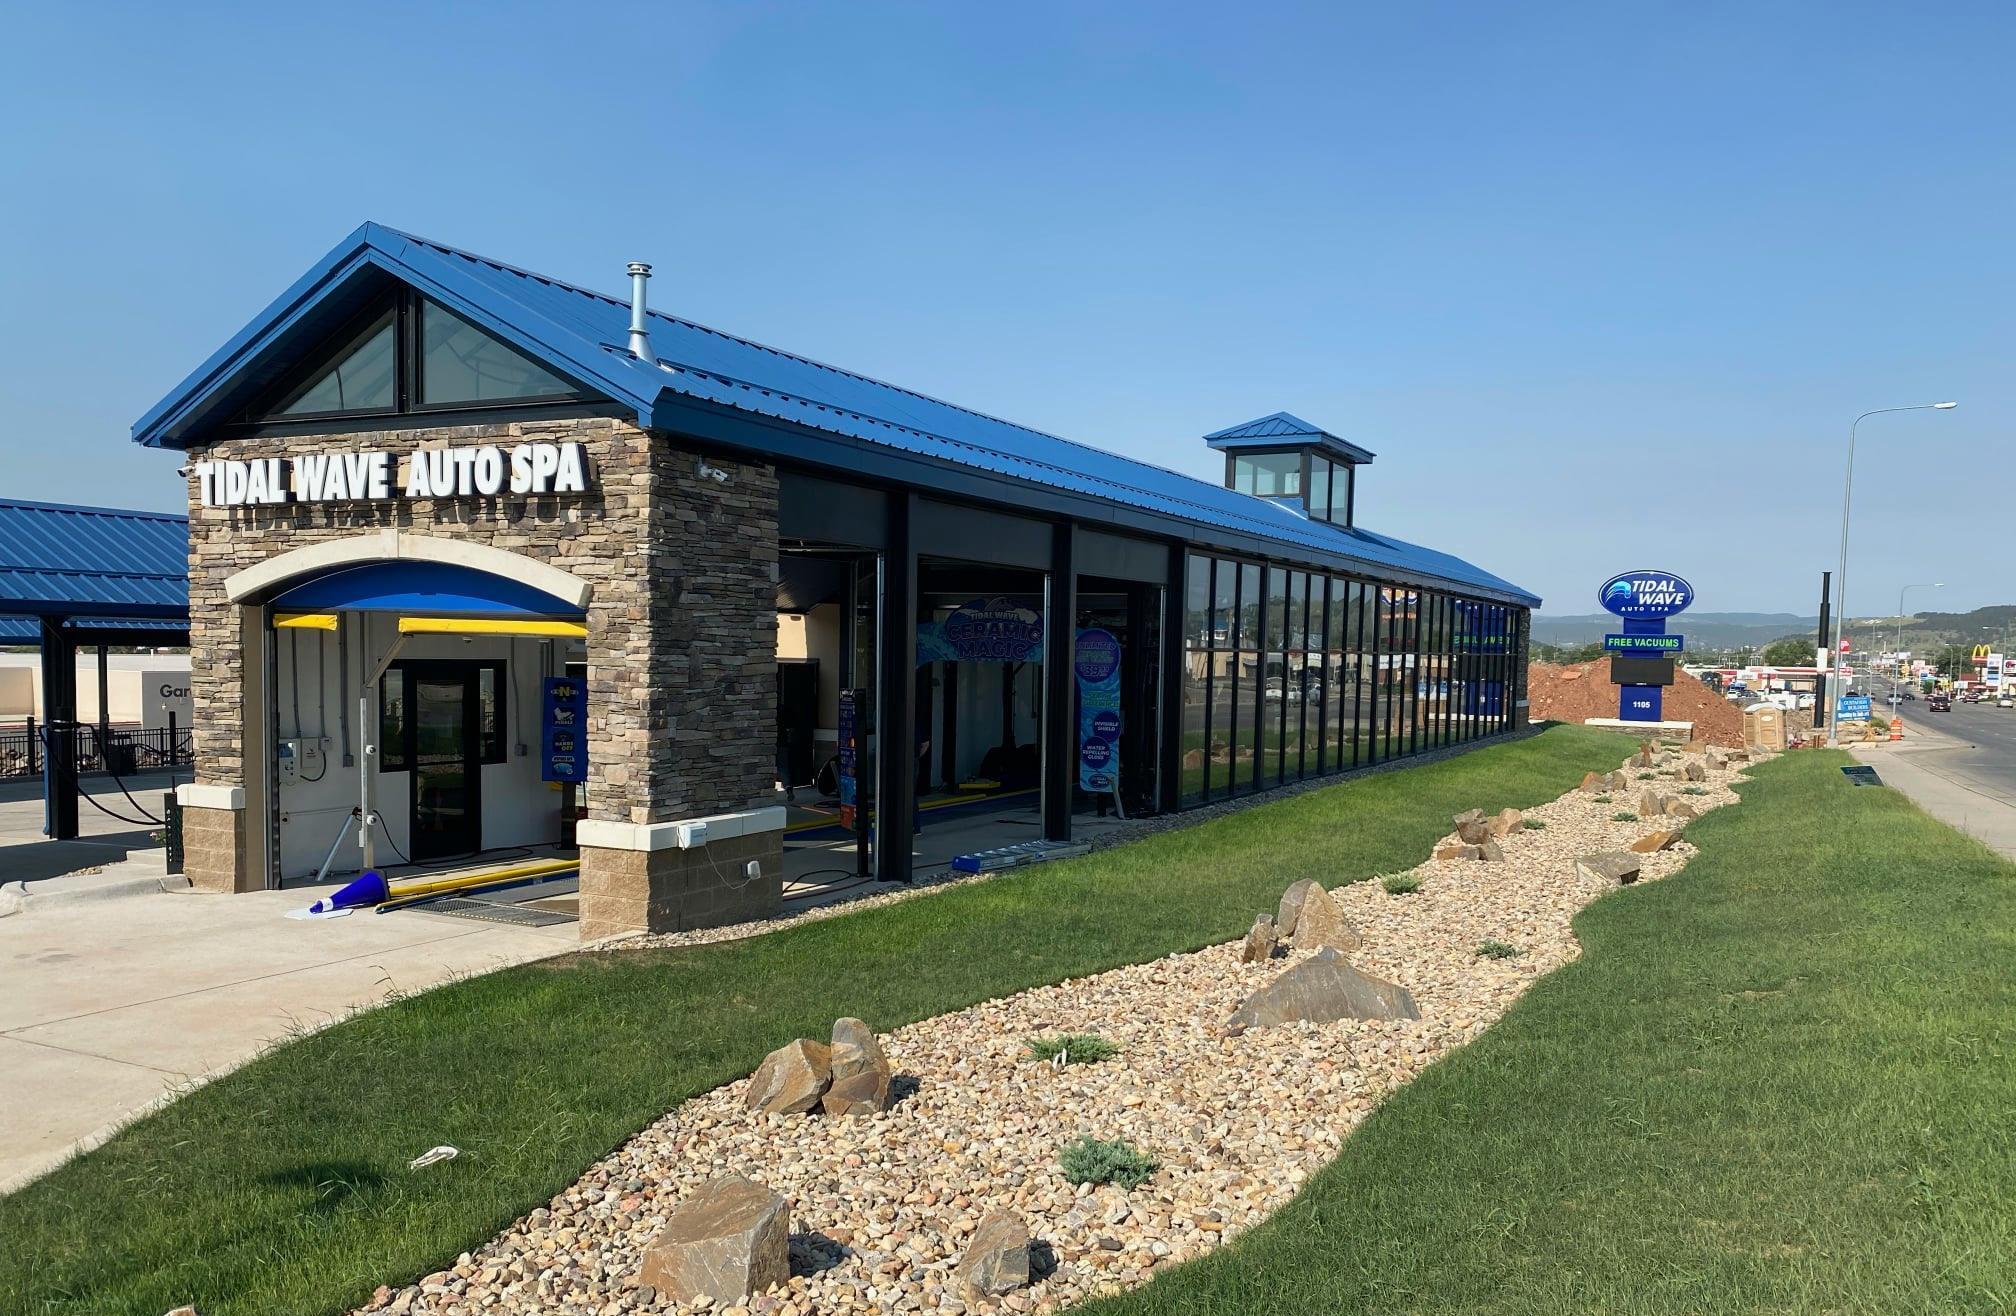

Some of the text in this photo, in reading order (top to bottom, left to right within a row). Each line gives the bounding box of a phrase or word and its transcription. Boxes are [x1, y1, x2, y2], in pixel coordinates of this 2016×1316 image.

[195, 443, 585, 506] TIDAL WAVE AUTO SPA
[1632, 581, 1676, 592] TIDAL
[1639, 593, 1685, 605] WAVE
[970, 611, 1019, 620] TIDAL WAVE
[948, 622, 1043, 643] CERAMIC
[1608, 638, 1680, 648] FREE VACUUMS
[958, 640, 1026, 660] MAGIC
[160, 684, 192, 698] Gar
